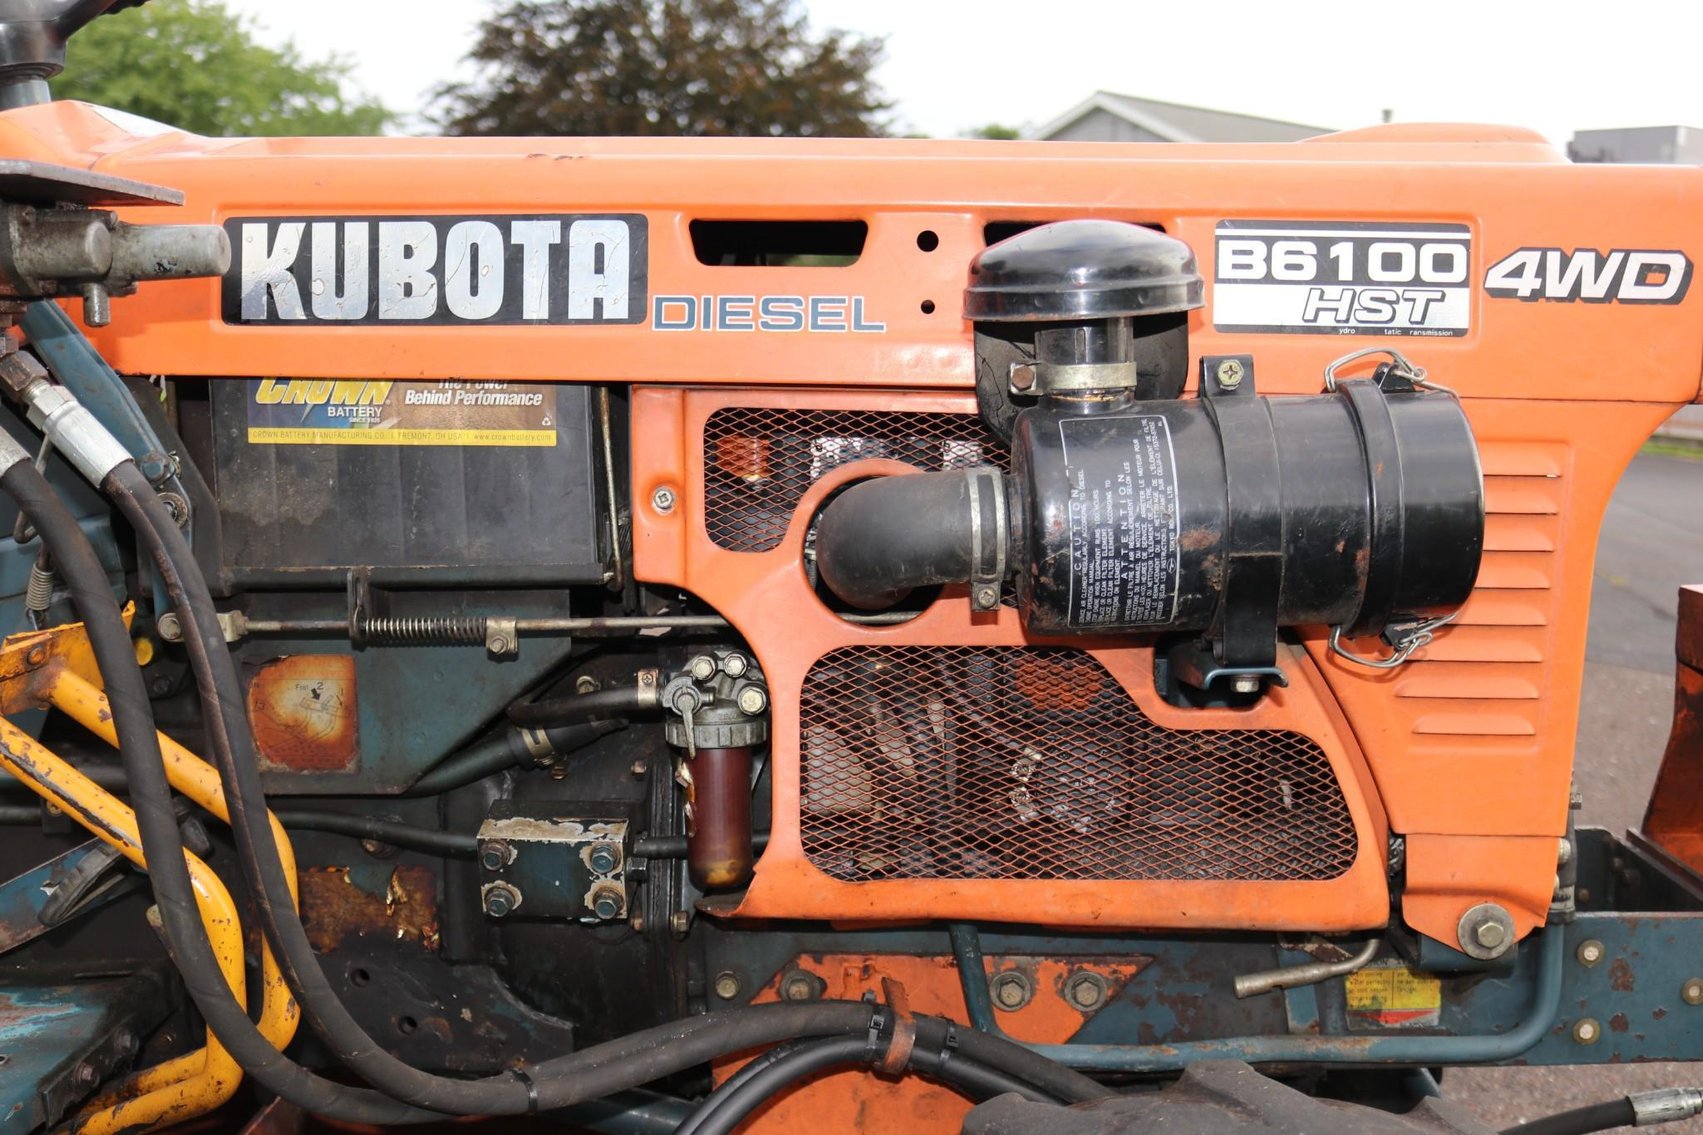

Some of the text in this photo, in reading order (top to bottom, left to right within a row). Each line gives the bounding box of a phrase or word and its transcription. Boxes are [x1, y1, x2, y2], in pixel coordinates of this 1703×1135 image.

[241, 220, 630, 320] KUBOTA
[1218, 240, 1469, 283] B6100
[1484, 247, 1694, 304] 4WD
[652, 295, 887, 333] DIESEL
[1302, 287, 1446, 325] HST
[1338, 328, 1356, 336] ydro
[327, 407, 383, 417] BATTERY
[404, 389, 543, 406] Behind Performance
[252, 430, 279, 438] CROWN
[280, 431, 310, 439] BATTERY
[312, 431, 373, 440] MANUFACTURING
[1072, 490, 1081, 570] CAUTION
[1118, 474, 1128, 579] ATTENTION
